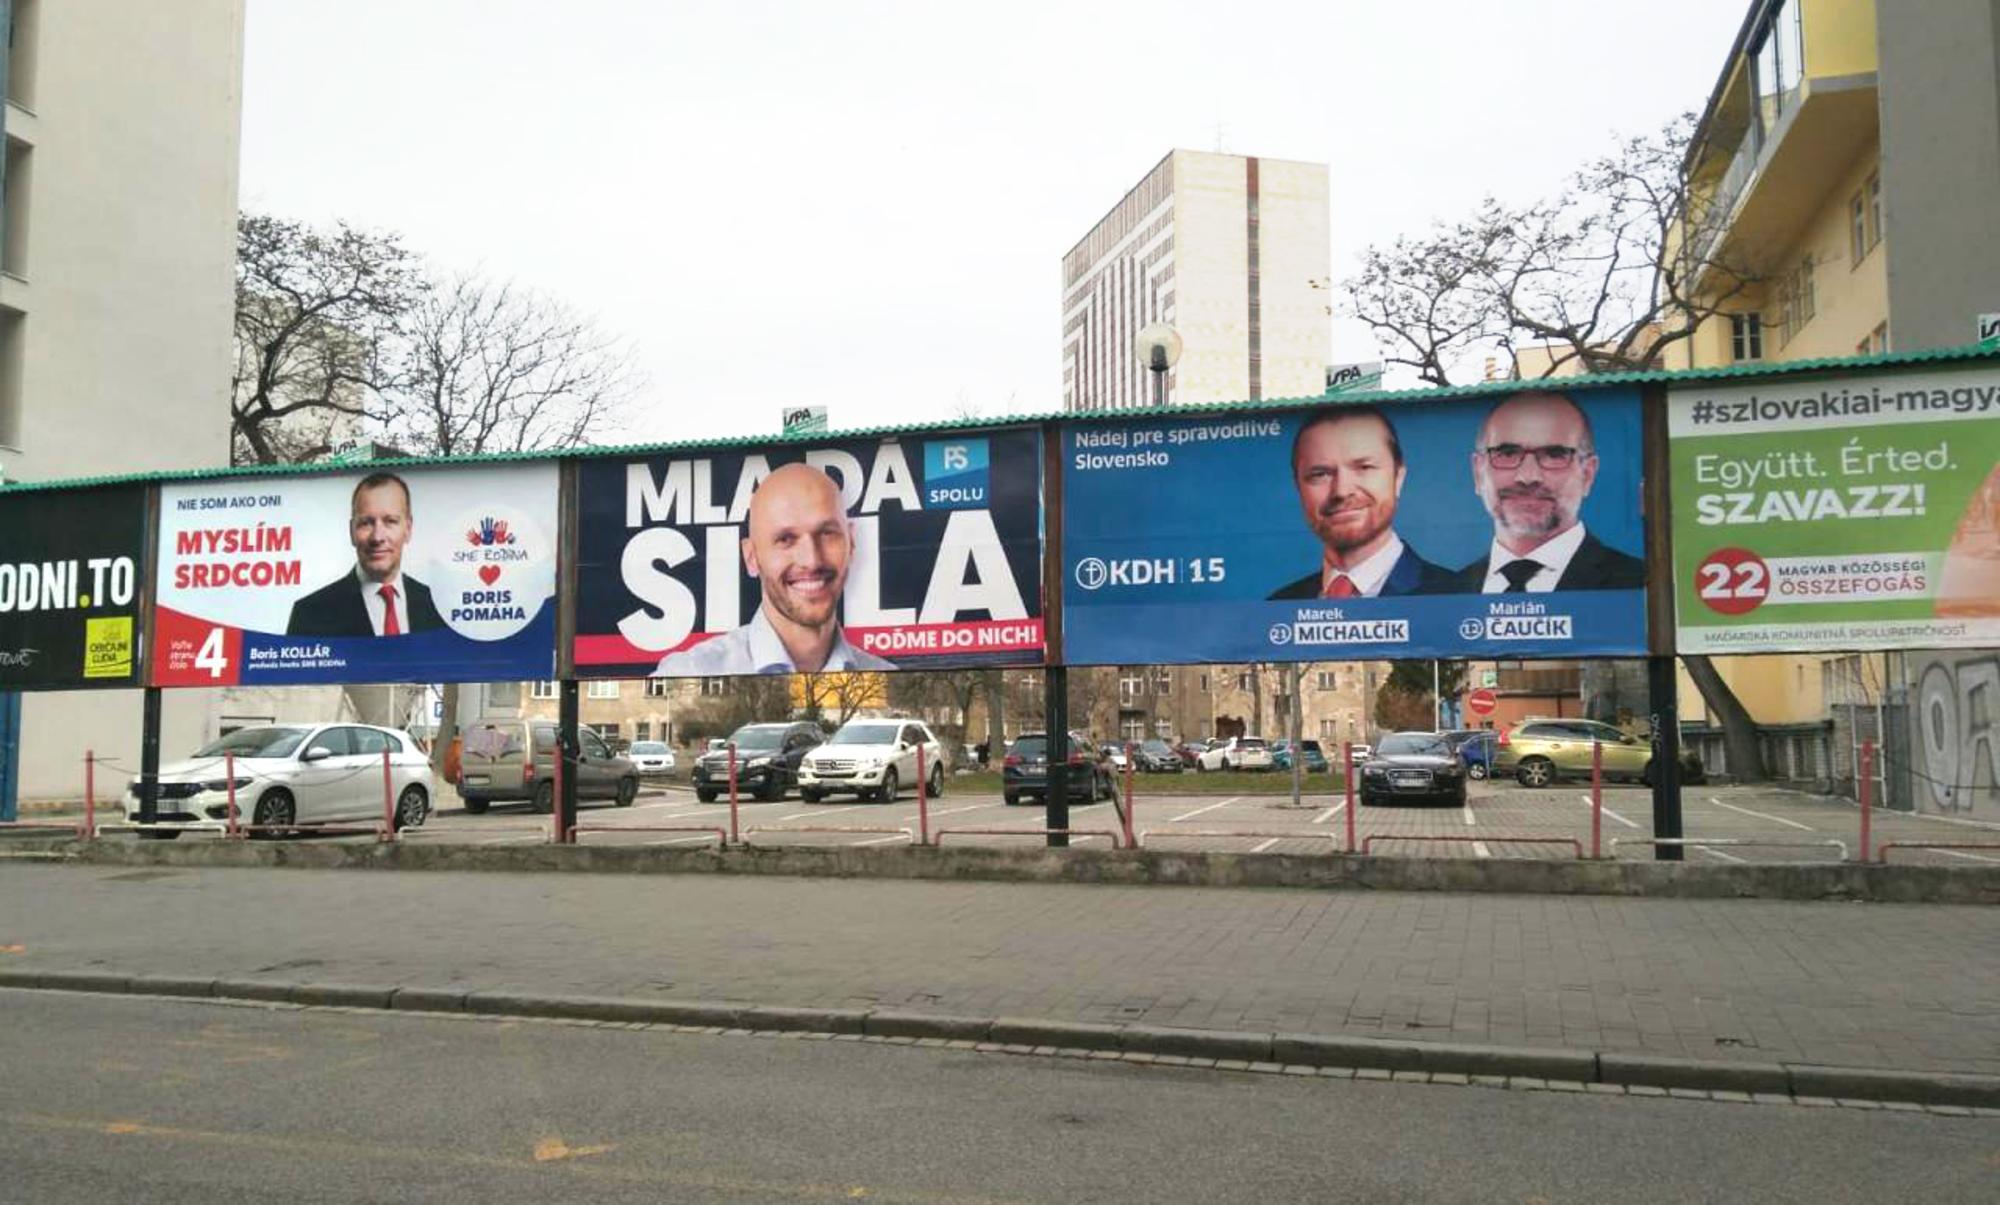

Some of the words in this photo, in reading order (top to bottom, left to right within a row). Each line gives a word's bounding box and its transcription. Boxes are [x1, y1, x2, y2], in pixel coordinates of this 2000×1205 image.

[1692, 386, 2000, 424] #szlovakiai-magy
[1076, 431, 1127, 448] Nádej
[1133, 430, 1163, 446] pre
[1168, 420, 1281, 444] spravodlivé
[1076, 451, 1169, 469] Slovensko
[1696, 452, 1827, 488] Együtt.
[1842, 437, 1957, 475] Érted.
[178, 499, 197, 510] NIE
[200, 497, 227, 509] SOM
[230, 496, 256, 508] AKO
[259, 495, 281, 507] ONI
[930, 488, 983, 503] SPOLU
[1696, 484, 1926, 525] SZAVAZZ!
[177, 521, 292, 555] MYSLÍM
[174, 560, 301, 590] SRDCOM
[1110, 559, 1175, 585] KDH
[1190, 557, 1225, 582] 15
[1701, 562, 1765, 599] 22
[1779, 564, 1836, 576] MAGYAR
[1779, 573, 1926, 595] ÖSSZEFOGÁS
[462, 590, 512, 604] BORIS
[1490, 601, 1545, 615] Marián
[451, 605, 526, 621] POMÁHA
[1298, 608, 1343, 620] Marek
[942, 629, 973, 648] DO
[978, 626, 1038, 645] NICH!
[194, 627, 228, 678] 4
[250, 648, 278, 660] Boris
[281, 643, 330, 659] KOLLÁR
